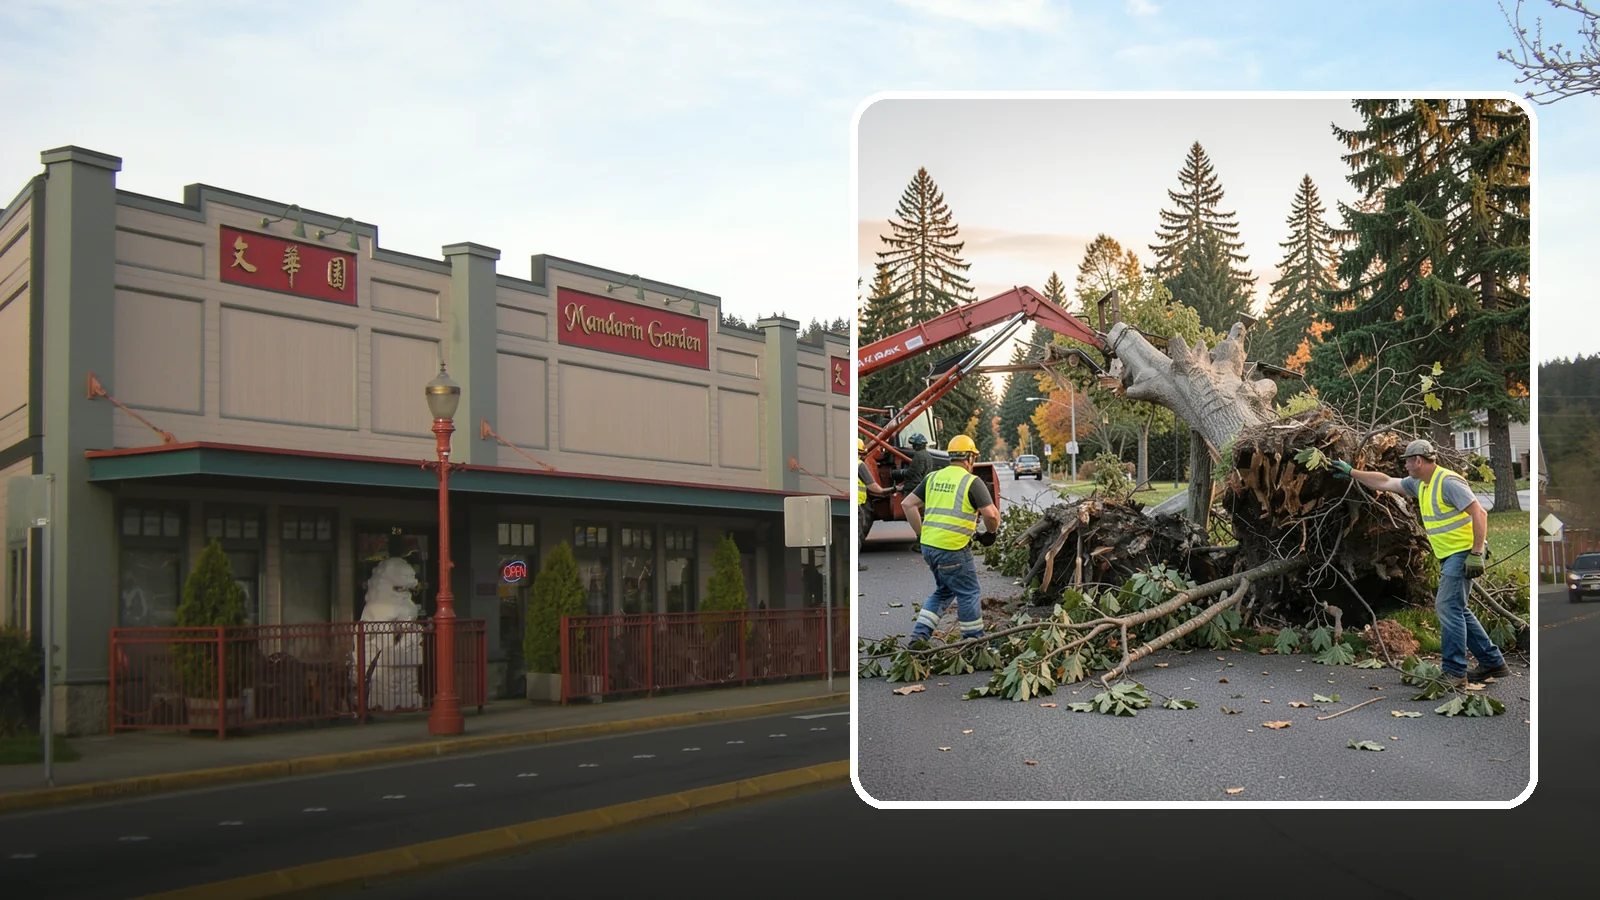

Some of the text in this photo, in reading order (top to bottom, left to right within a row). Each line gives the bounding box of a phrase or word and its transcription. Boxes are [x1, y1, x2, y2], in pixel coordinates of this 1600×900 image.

[231, 236, 346, 291] 文華園
[564, 302, 702, 352] Mandarin Garden
[503, 565, 527, 578] OPEN
